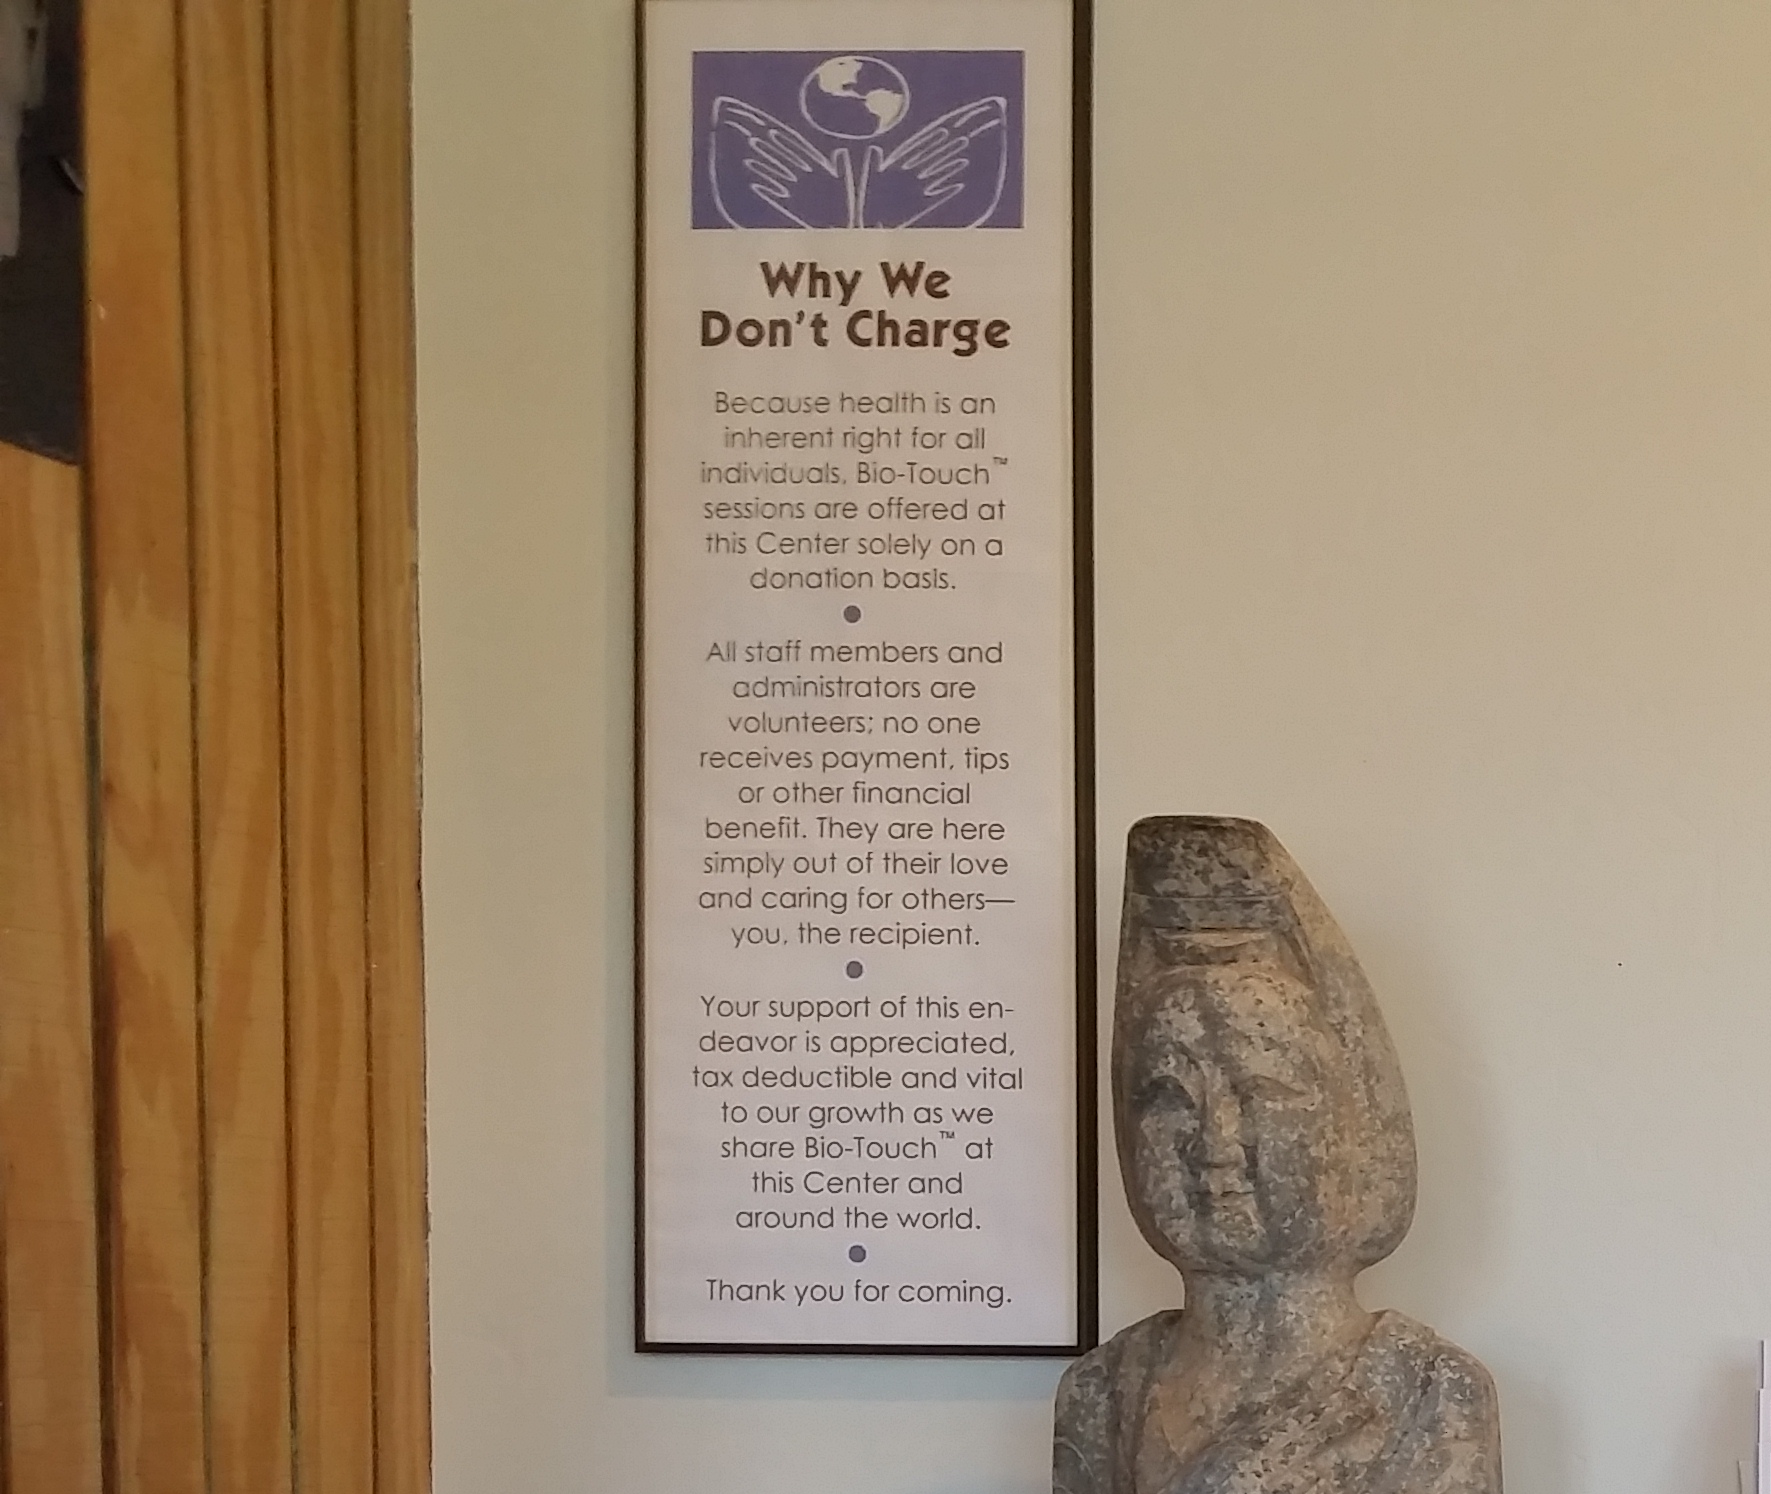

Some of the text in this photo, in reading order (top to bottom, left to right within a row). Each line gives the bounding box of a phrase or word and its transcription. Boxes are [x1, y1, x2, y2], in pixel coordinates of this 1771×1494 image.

[759, 260, 952, 308] Why We
[700, 308, 1012, 358] Don't Charge
[714, 390, 996, 415] Because health is an
[724, 425, 986, 455] inherent right for all
[700, 460, 848, 486] individuals,
[749, 566, 957, 590] donation basis.
[732, 674, 977, 700] administrators are
[728, 711, 982, 736] volunteers; no one
[699, 745, 1010, 775] receives payment, tips
[730, 921, 980, 950] you, the recipient.
[698, 1029, 1015, 1059] deavor is appreciated,
[720, 1135, 796, 1159] share
[964, 1136, 994, 1160] at
[705, 1278, 1012, 1309] Thank you for coming.
